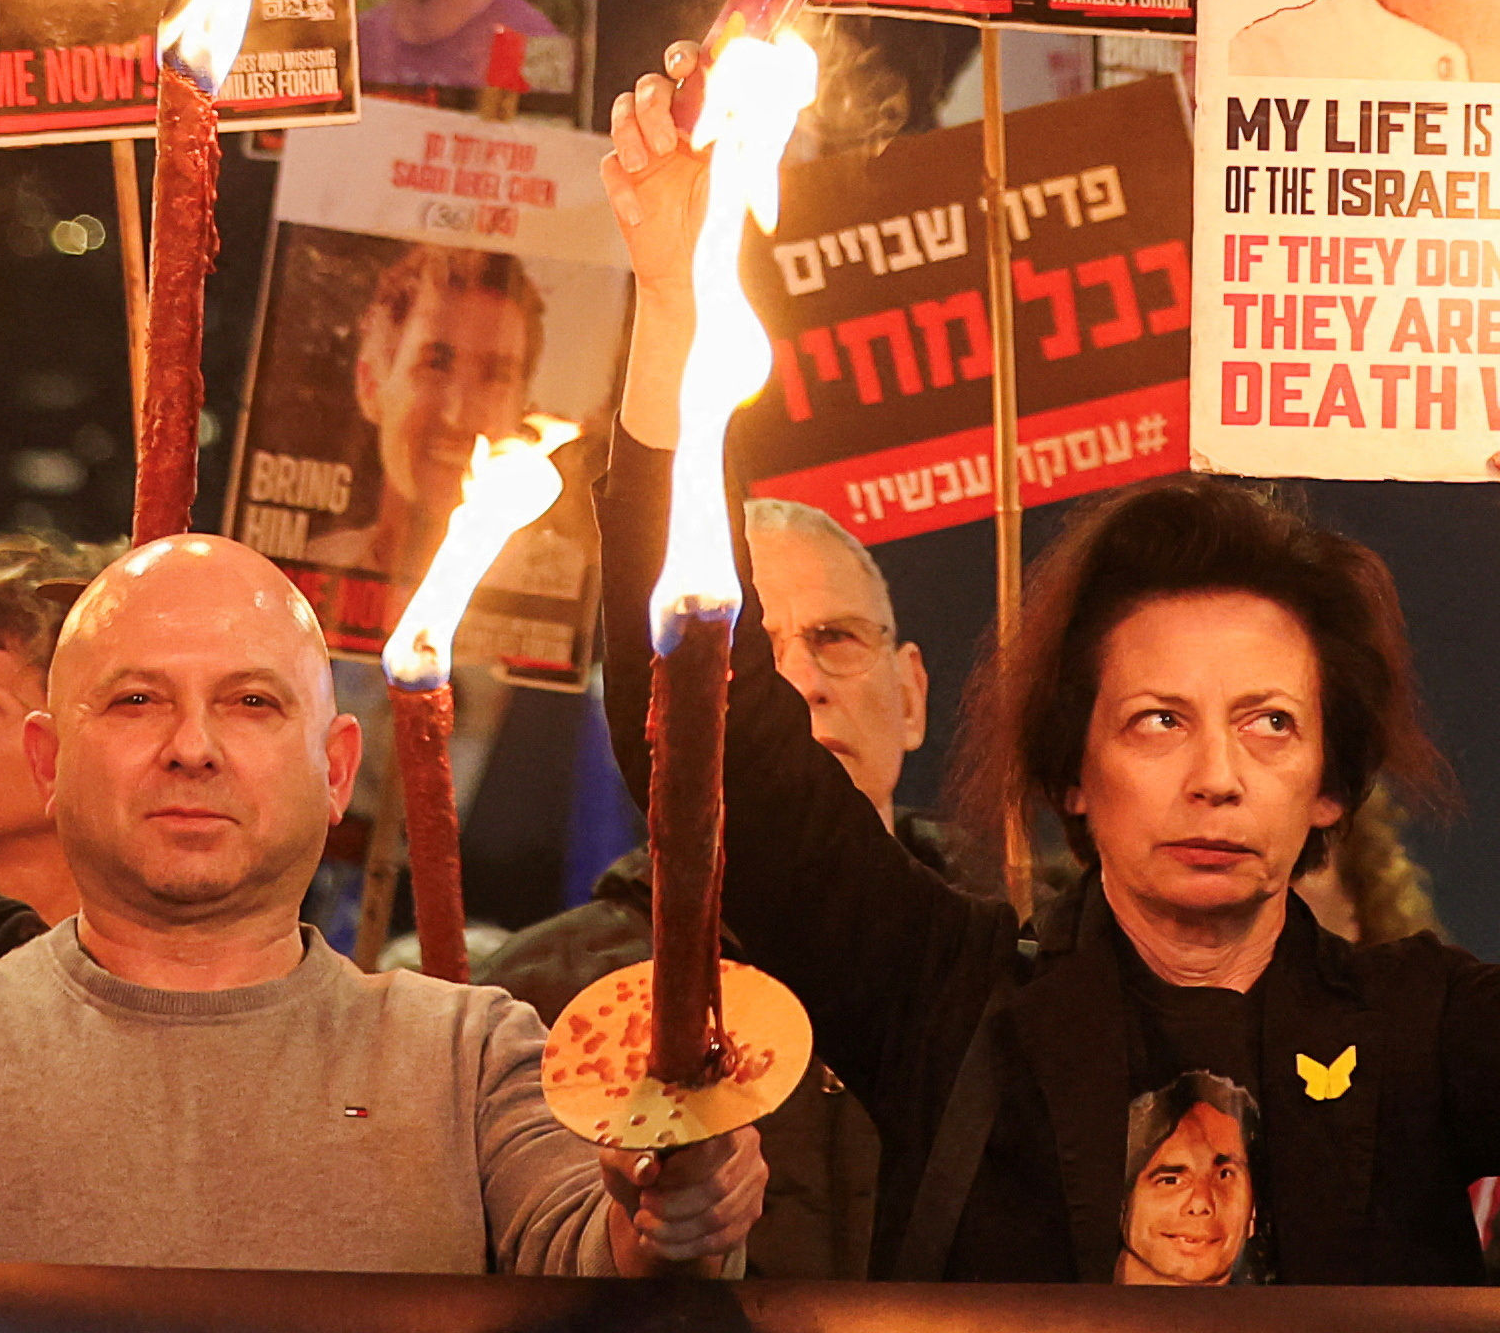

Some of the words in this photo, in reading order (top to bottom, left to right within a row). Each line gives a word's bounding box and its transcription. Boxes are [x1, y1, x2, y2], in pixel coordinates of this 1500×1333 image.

[44, 34, 157, 106] NOW!
[219, 73, 275, 100] MILIES
[277, 69, 339, 97] FORUM
[1226, 97, 1310, 152] MY
[1325, 99, 1448, 155] LIFE
[1463, 103, 1492, 157] IS
[980, 165, 1128, 241] פדיו
[1225, 165, 1260, 214] OF
[1265, 166, 1316, 215] THE
[774, 203, 968, 296] שבויים
[1223, 234, 1269, 282] IF
[1279, 235, 1405, 286] THEY
[1223, 293, 1377, 352] THEY
[1220, 360, 1457, 431] DEATH
[250, 451, 353, 515] BRING
[847, 454, 993, 524] עכשיו!
[242, 502, 310, 559] HIM
